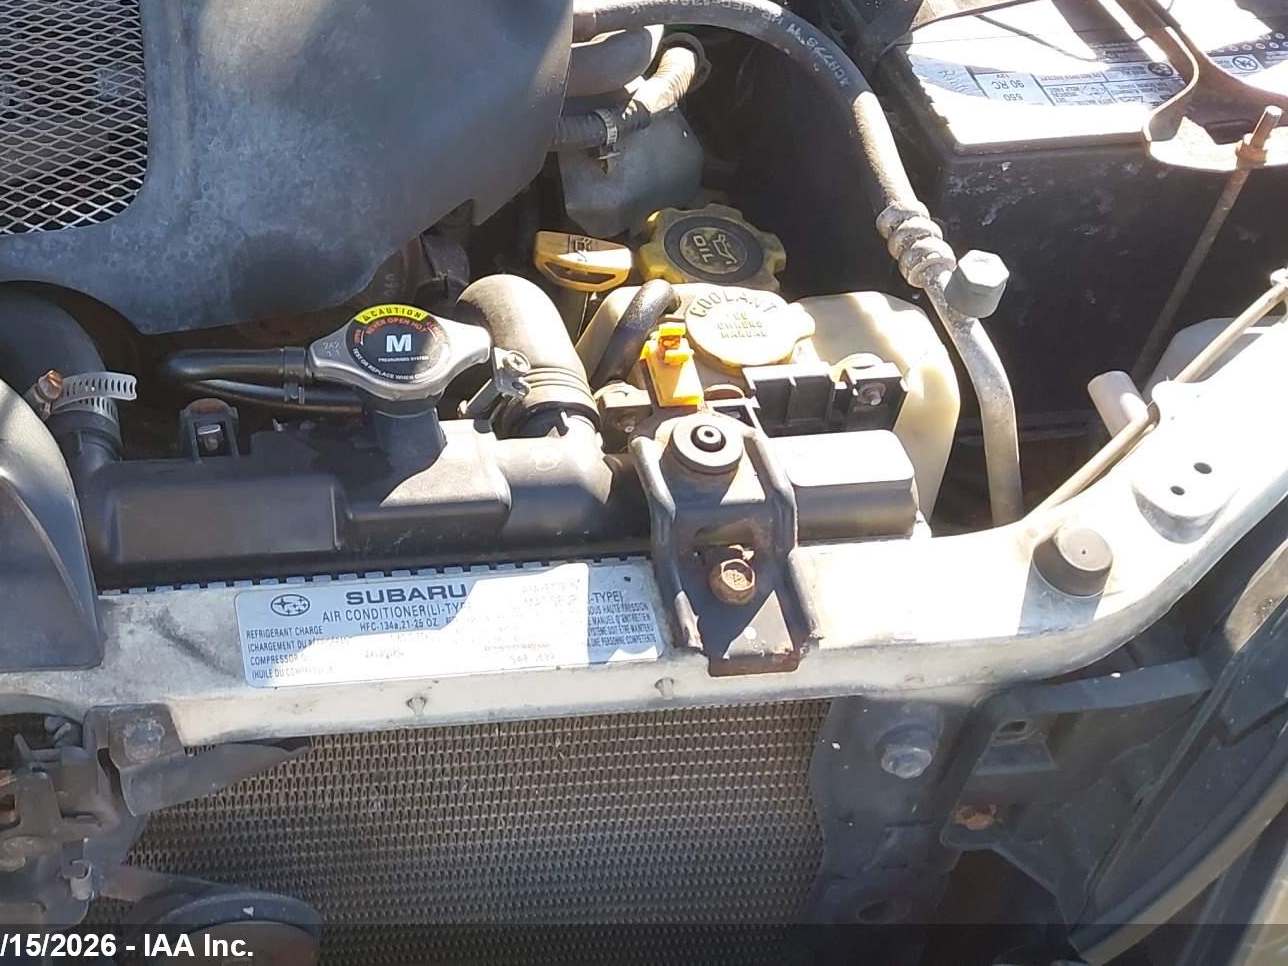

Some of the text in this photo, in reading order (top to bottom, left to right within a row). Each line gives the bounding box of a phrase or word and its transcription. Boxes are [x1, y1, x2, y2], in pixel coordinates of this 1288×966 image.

[692, 235, 715, 263] OIL
[371, 306, 423, 318] CAUTION
[388, 317, 410, 325] OPEN
[386, 334, 412, 352] M
[368, 365, 395, 379] REPLACE
[345, 583, 467, 606] SUBARU
[322, 611, 341, 623] AIR
[246, 625, 323, 640] REFRIGERANT CHARGE
[297, 638, 307, 649] DU
